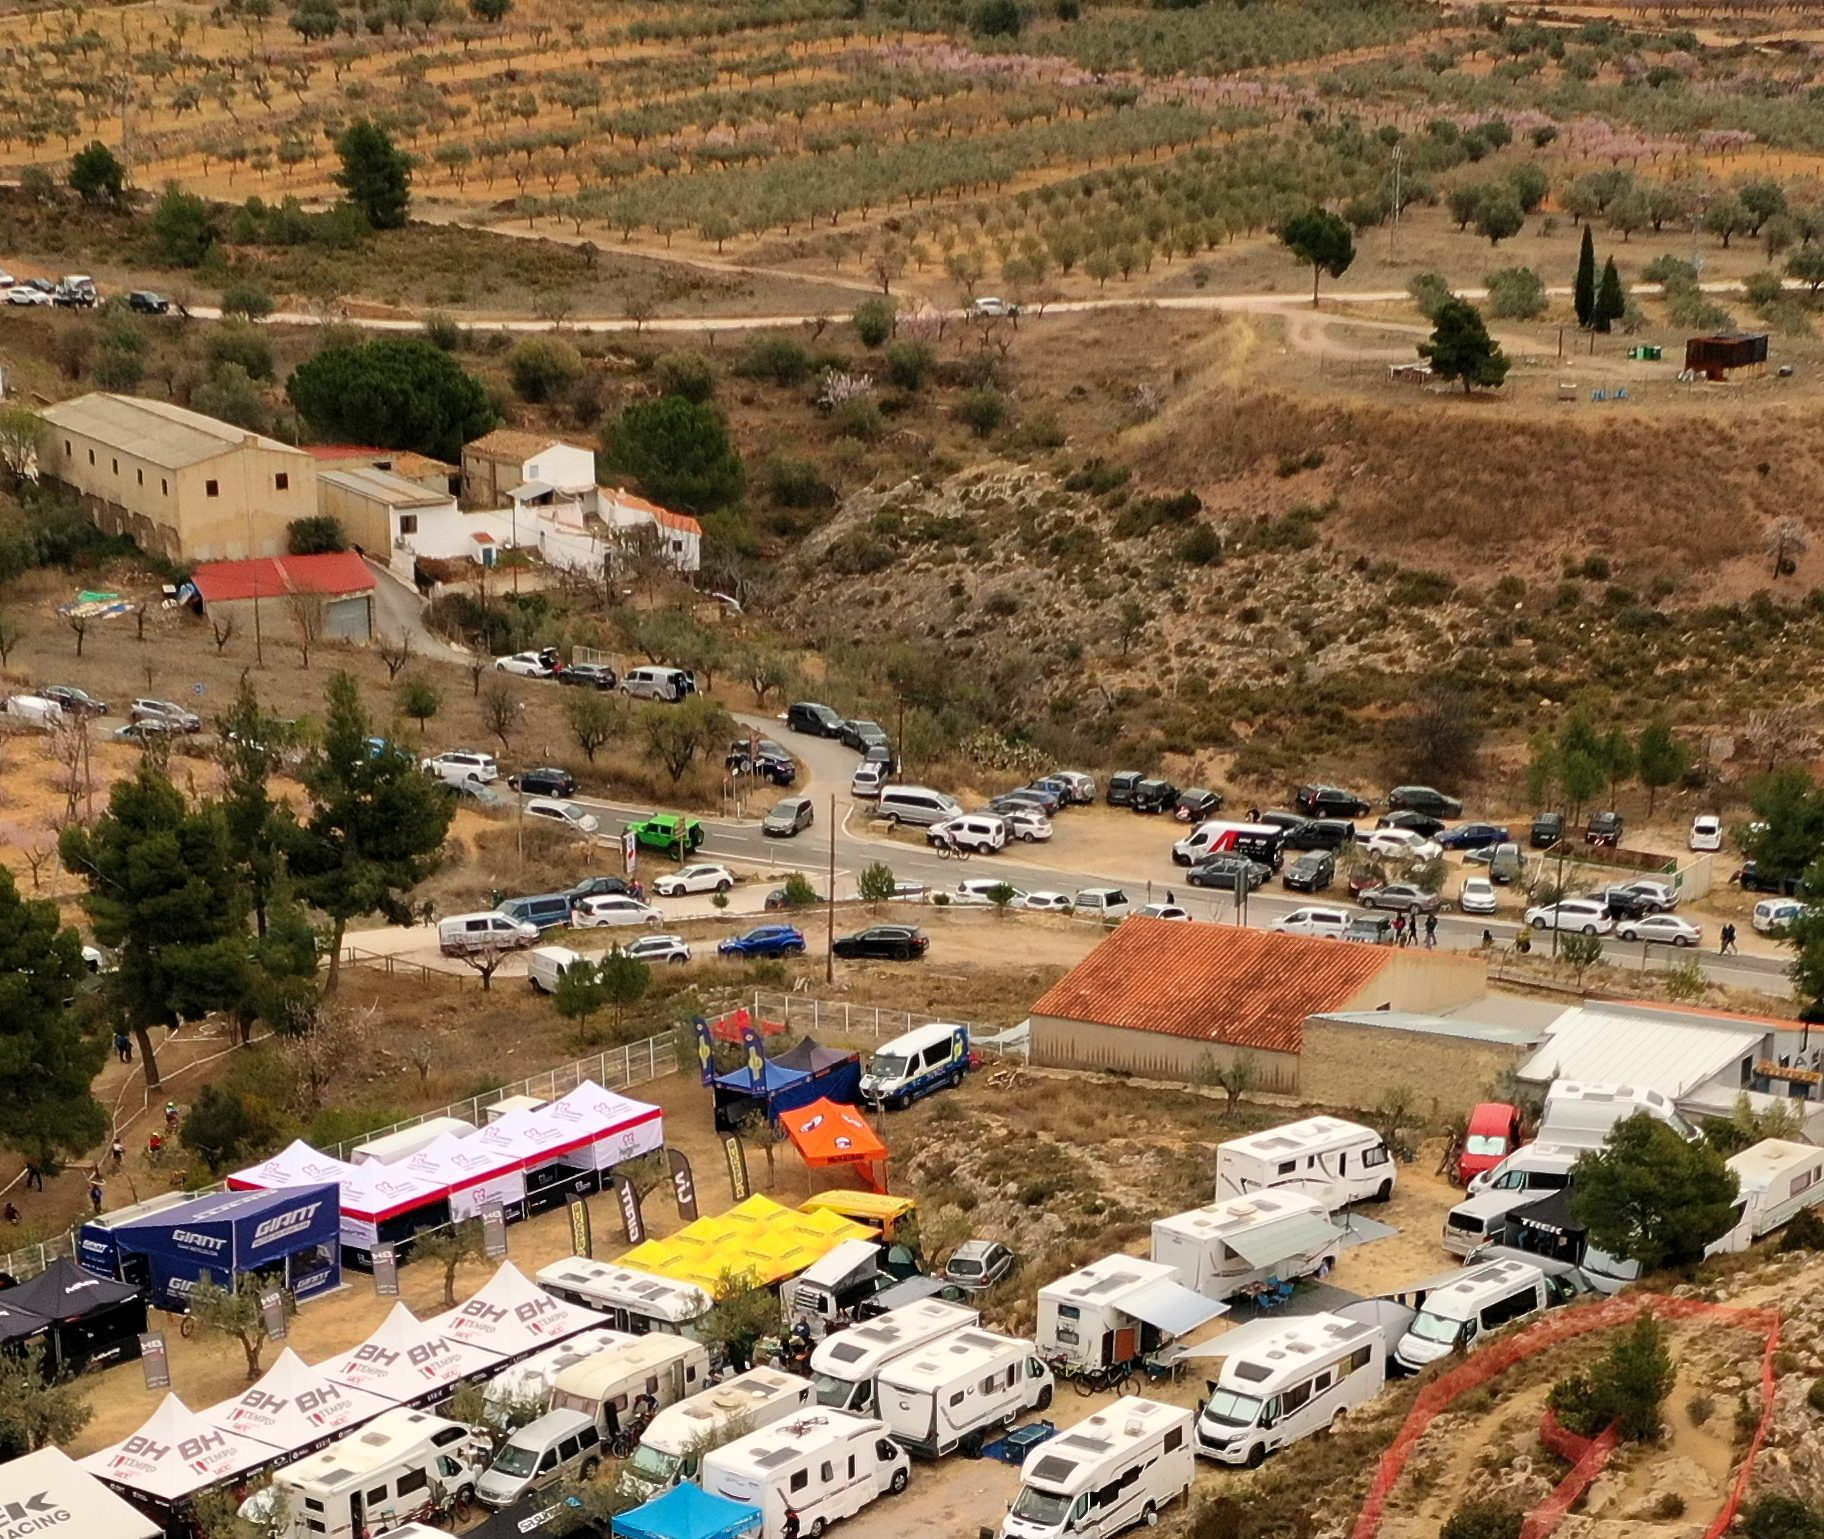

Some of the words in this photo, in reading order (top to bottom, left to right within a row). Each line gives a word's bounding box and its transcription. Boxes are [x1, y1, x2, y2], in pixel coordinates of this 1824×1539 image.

[255, 1201, 323, 1238] GIANT
[1520, 1217, 1564, 1235] TREK
[172, 1229, 228, 1250] GIANT
[461, 1299, 509, 1323] BH
[514, 1295, 558, 1323] BH
[353, 1343, 401, 1367] BH
[406, 1338, 451, 1366] BH
[240, 1389, 289, 1414] BH
[295, 1383, 341, 1414] BH
[122, 1436, 172, 1461] BH
[177, 1430, 226, 1461] BH
